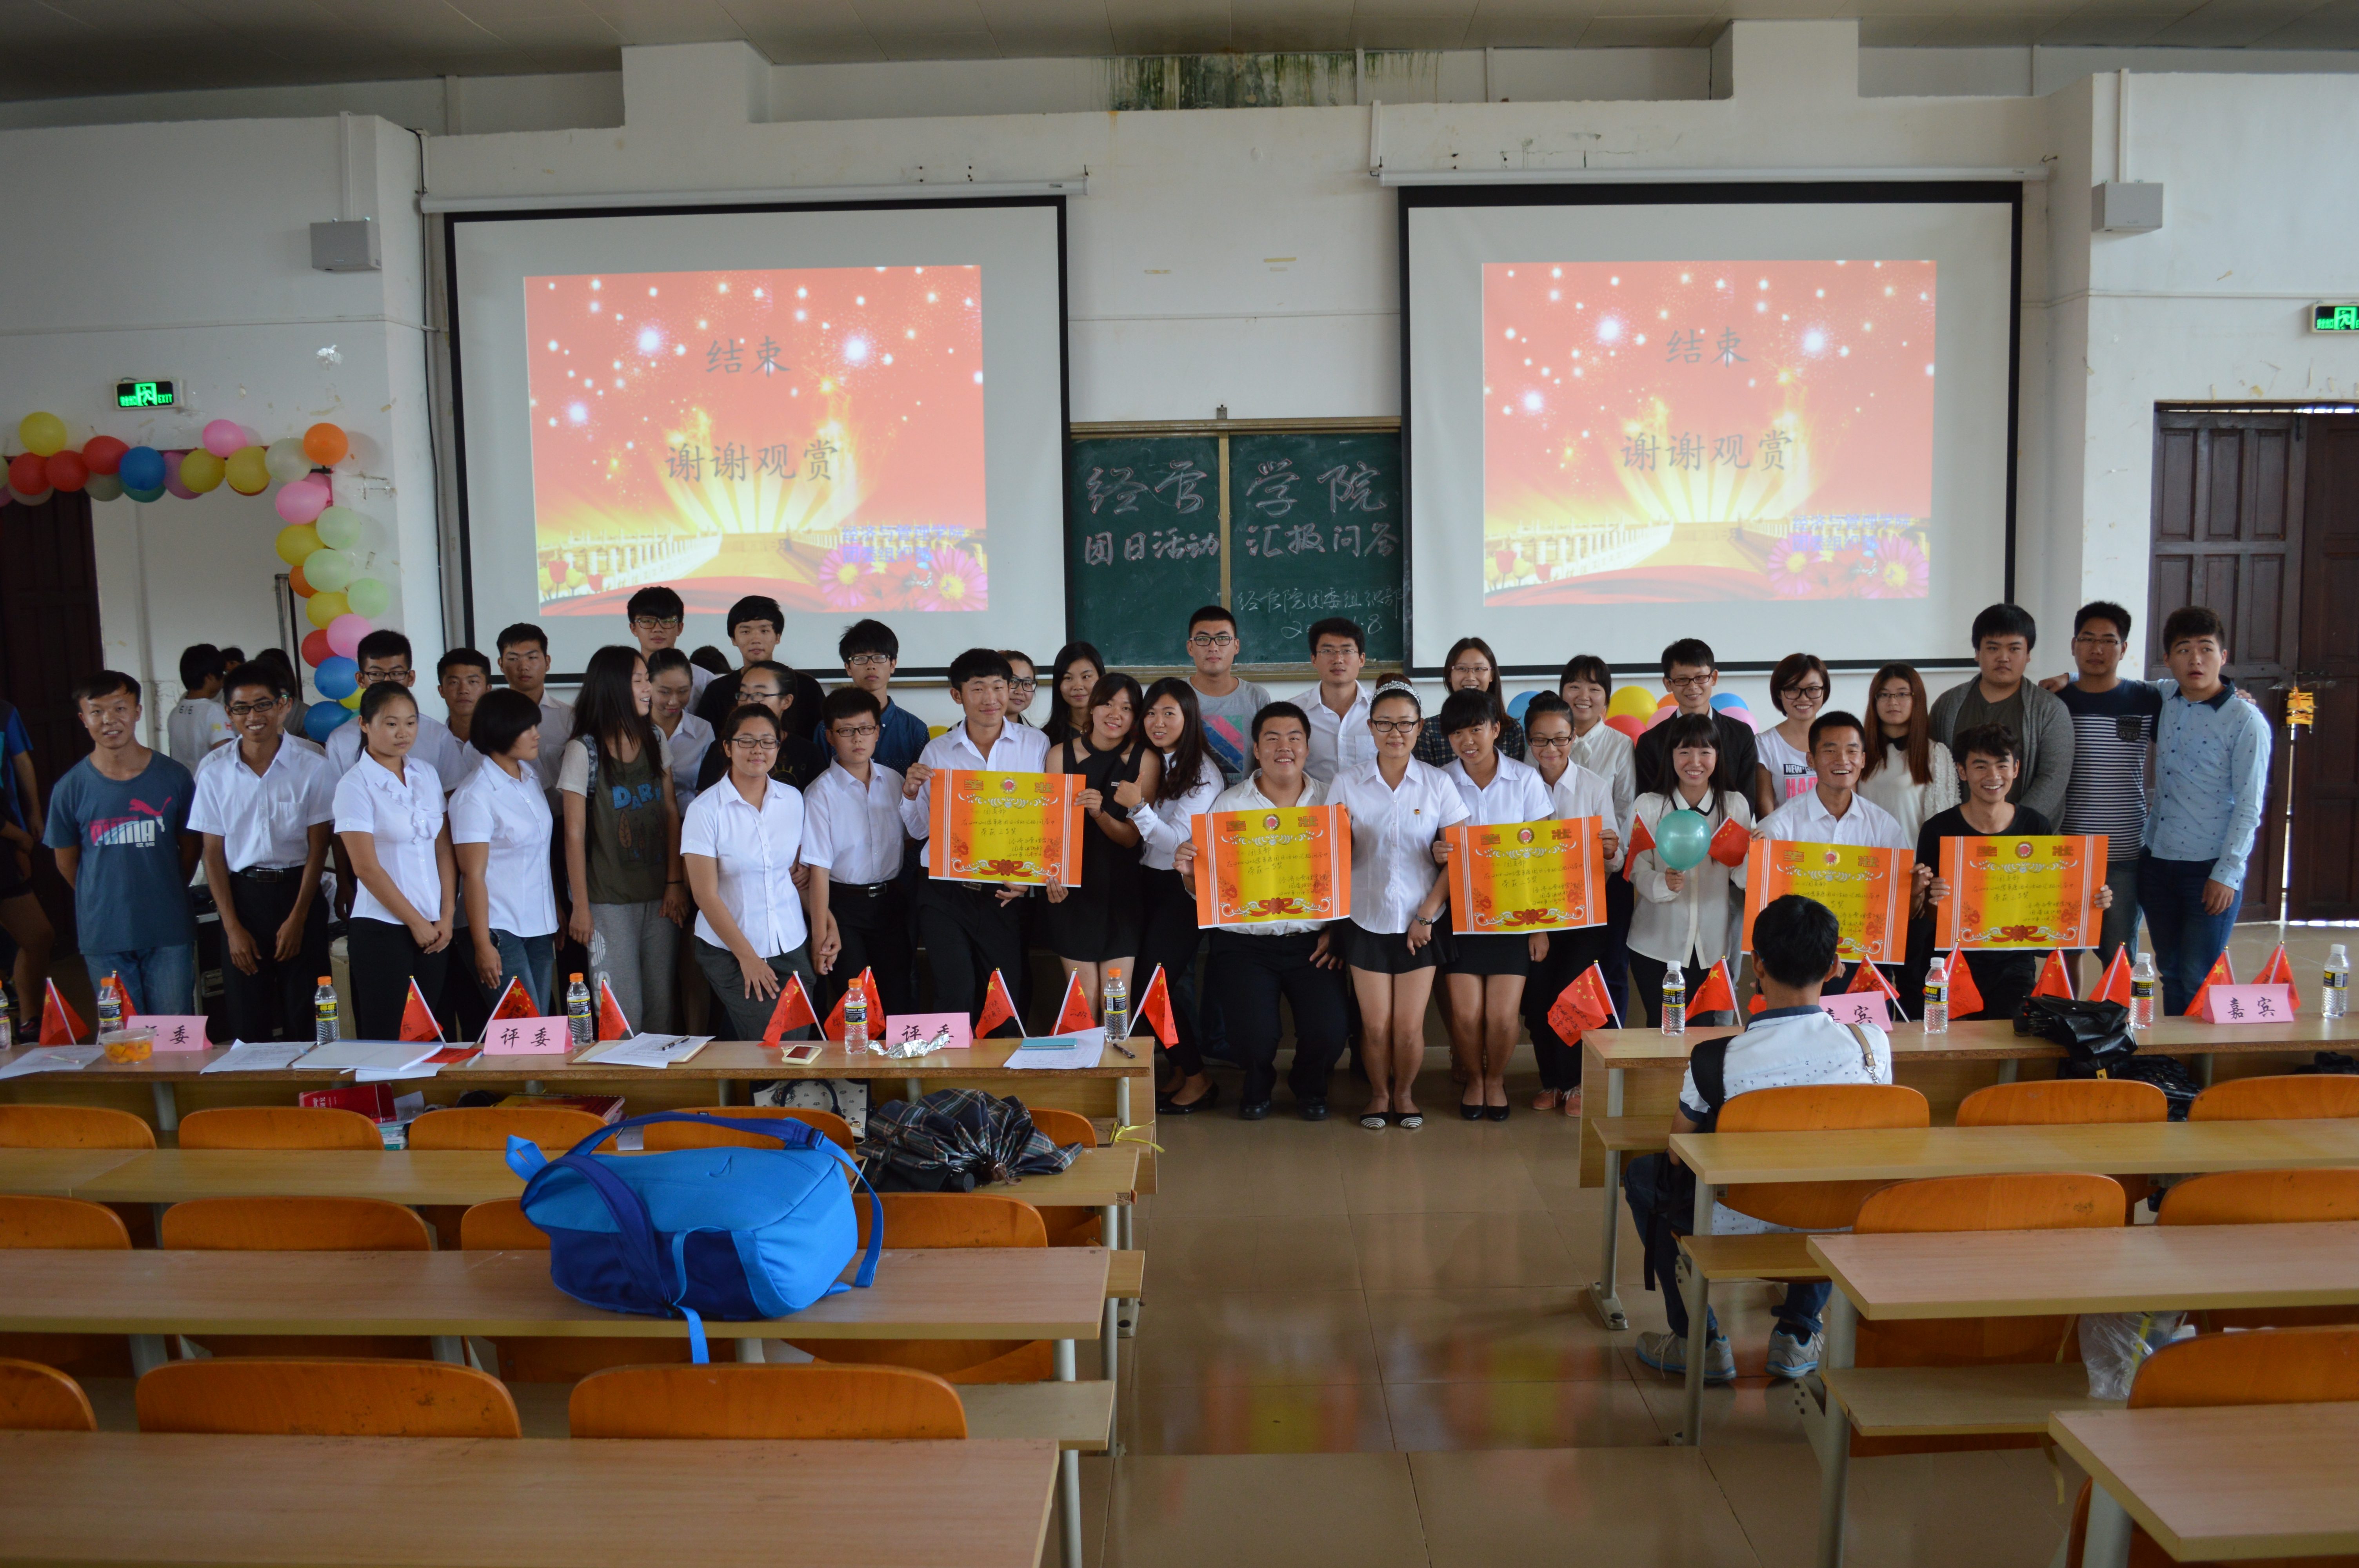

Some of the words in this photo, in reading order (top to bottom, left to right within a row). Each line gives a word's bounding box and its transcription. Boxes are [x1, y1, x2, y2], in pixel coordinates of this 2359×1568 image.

[706, 336, 791, 378] 结束
[1665, 327, 1750, 368] 结束
[158, 394, 173, 403] EXIT
[665, 439, 838, 482] 谢谢观赏
[1620, 430, 1792, 472] 谢谢观赏
[1792, 514, 1912, 530] 经济与管理学院
[843, 524, 966, 542] 经济与管理学院
[1792, 535, 1878, 551] 团委组织部
[843, 546, 932, 563] 团委组织部
[90, 819, 155, 846] PUMA
[145, 1025, 189, 1044] 委
